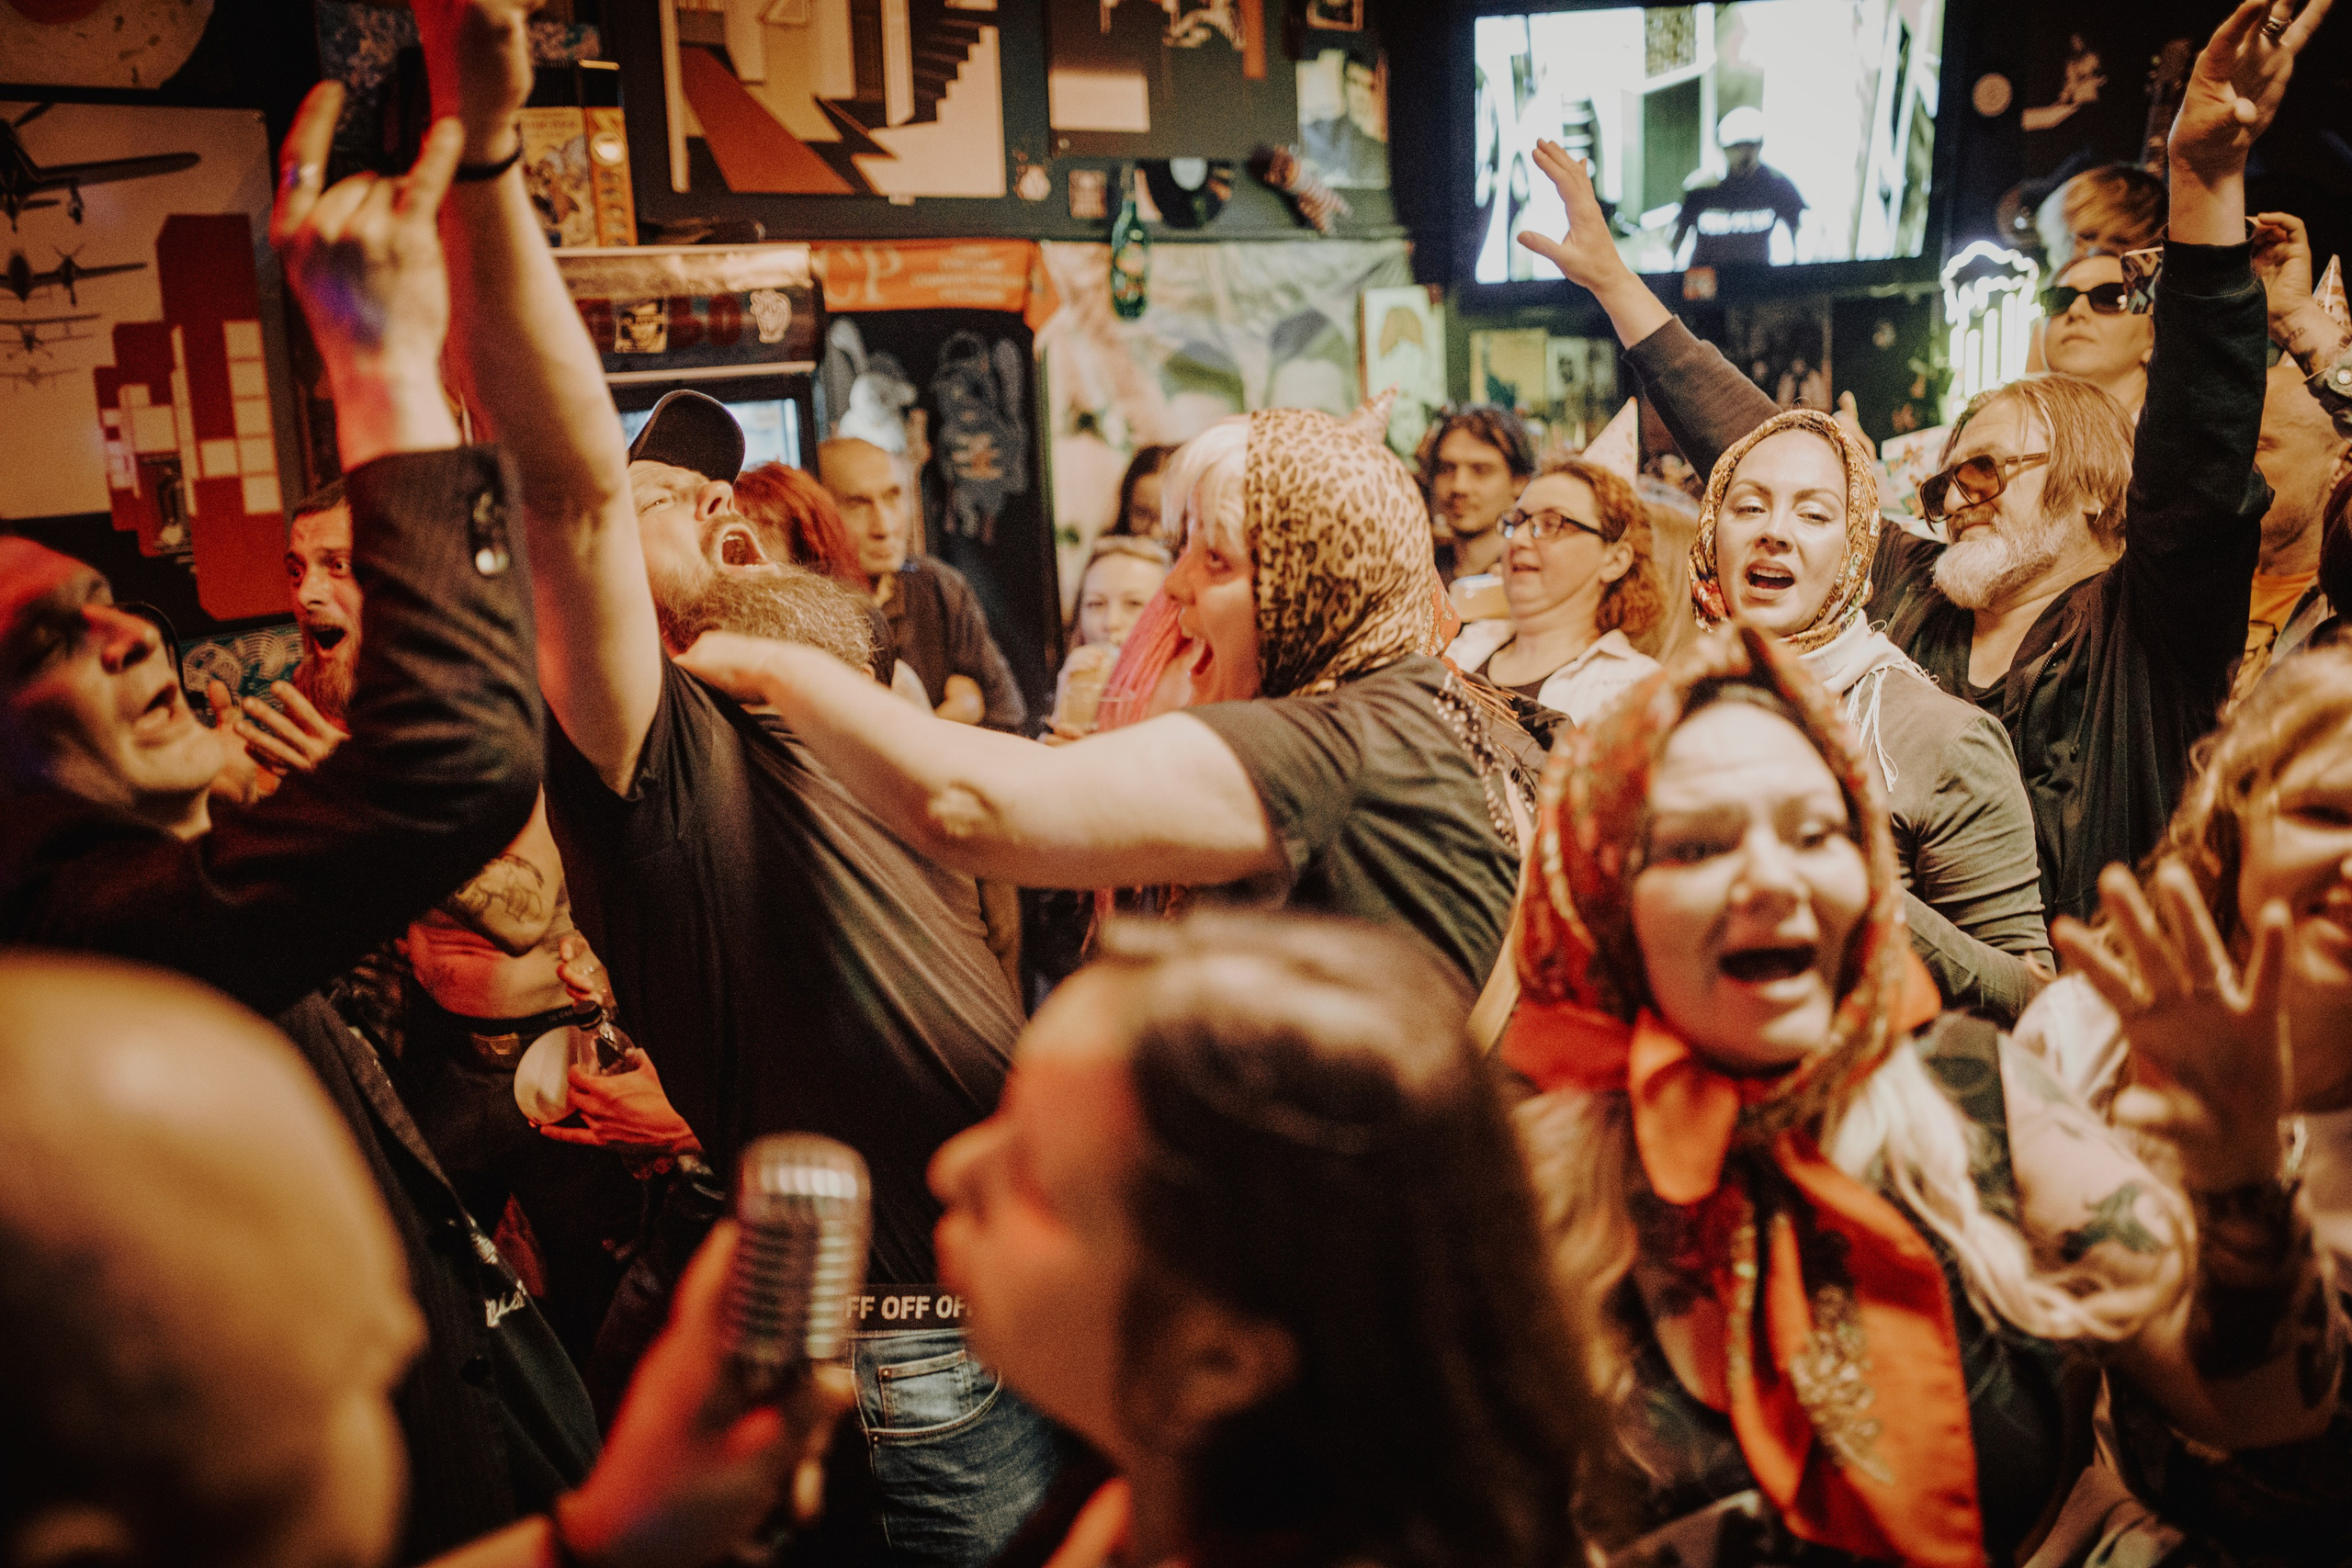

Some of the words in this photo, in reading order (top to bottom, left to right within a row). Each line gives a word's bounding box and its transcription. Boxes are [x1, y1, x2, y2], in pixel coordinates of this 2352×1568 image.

[844, 1295, 876, 1320] FF
[881, 1294, 931, 1320] OFF
[935, 1294, 972, 1319] OF
